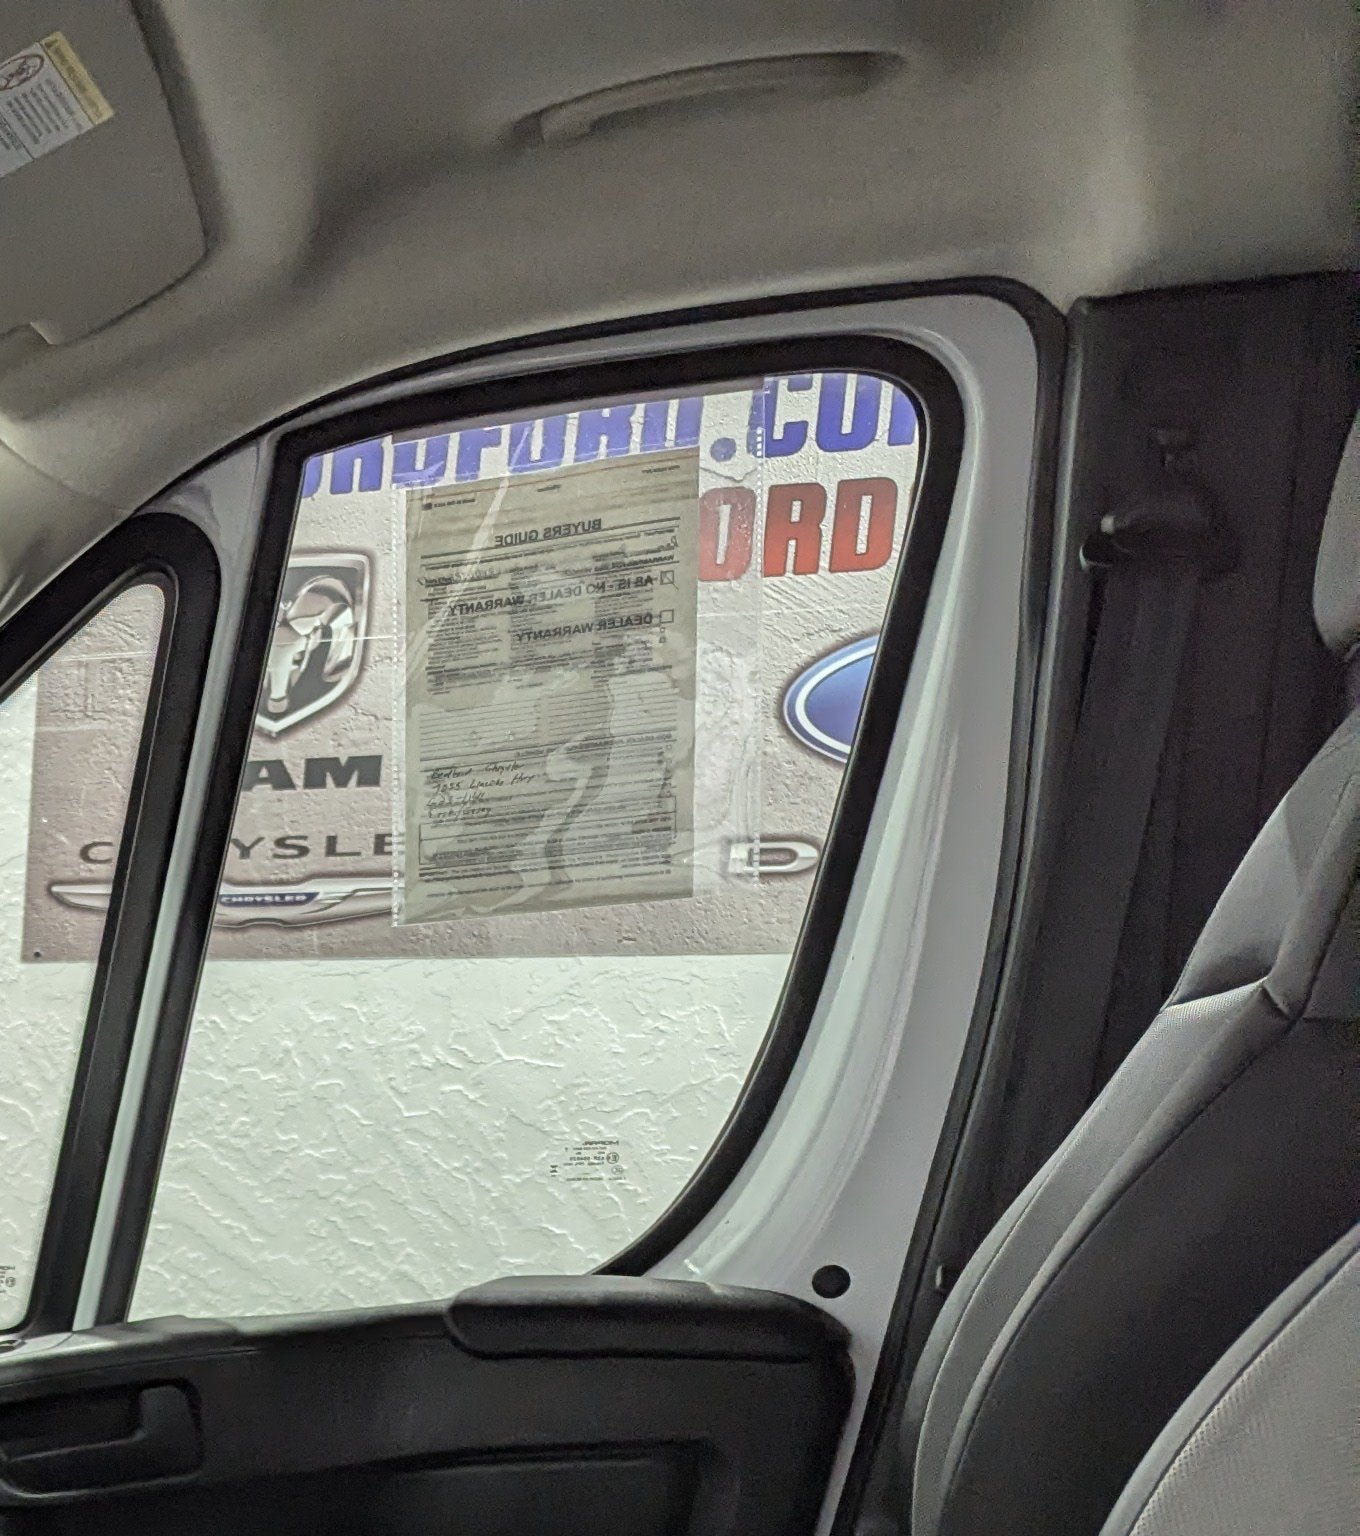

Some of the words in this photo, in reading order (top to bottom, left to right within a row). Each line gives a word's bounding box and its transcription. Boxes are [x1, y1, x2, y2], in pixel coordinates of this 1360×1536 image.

[698, 477, 898, 582] ORD
[242, 755, 382, 791] AM
[80, 833, 406, 865] CYSLE
[220, 894, 308, 904] CHRYSLER
